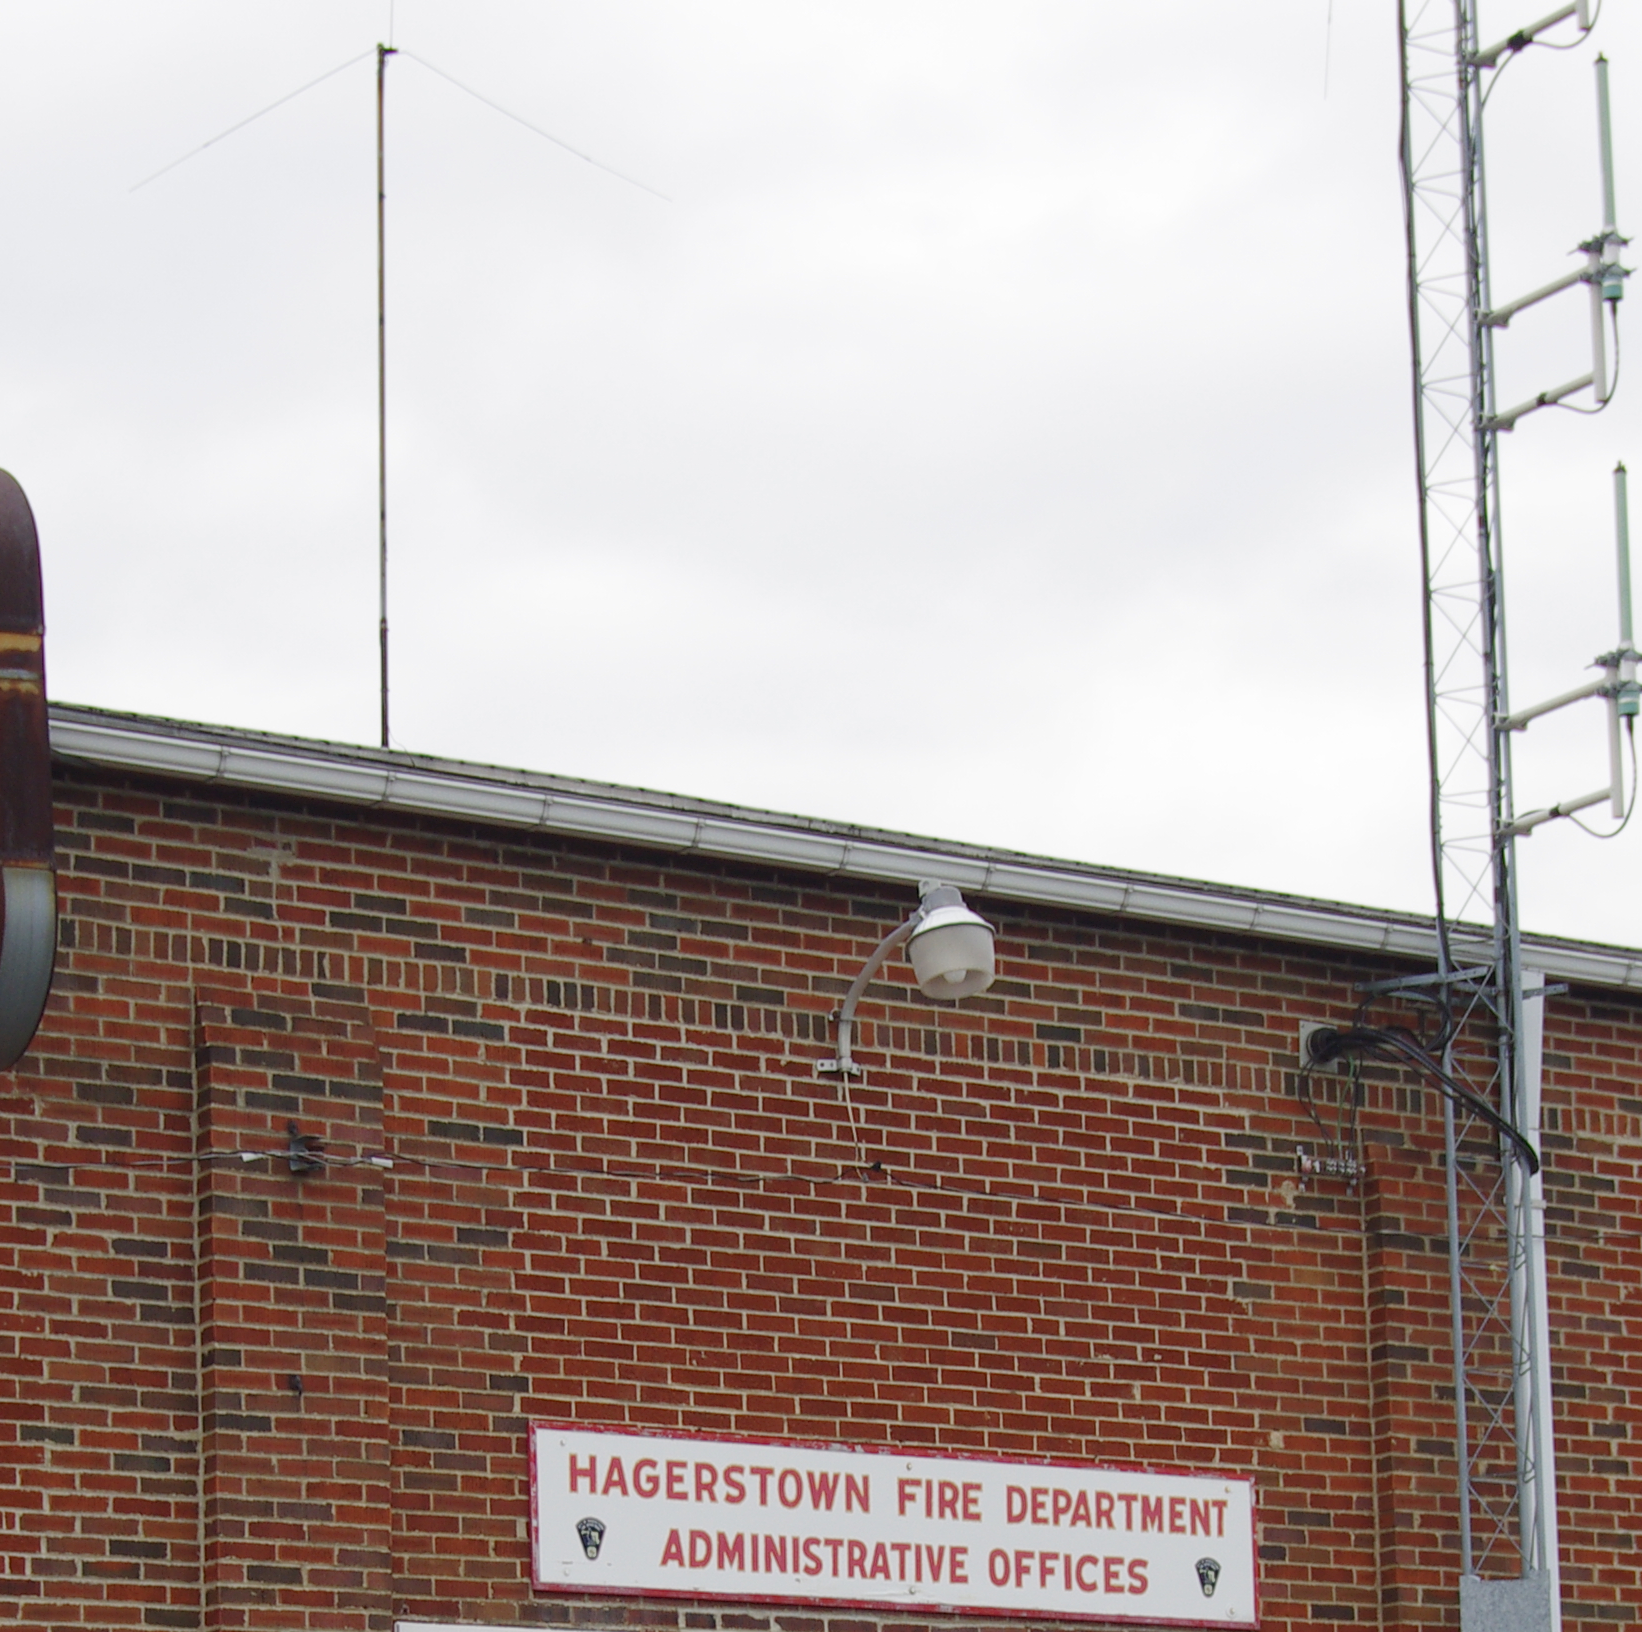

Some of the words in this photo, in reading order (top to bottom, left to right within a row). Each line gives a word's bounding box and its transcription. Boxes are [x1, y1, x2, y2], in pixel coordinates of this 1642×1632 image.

[568, 1453, 870, 1515] HAGERSTOWN
[897, 1476, 982, 1522] FIRE
[1006, 1486, 1228, 1538] DEPARTMENT
[660, 1529, 970, 1585] ADMINISTRATIVE
[988, 1549, 1150, 1594] OFFICES
